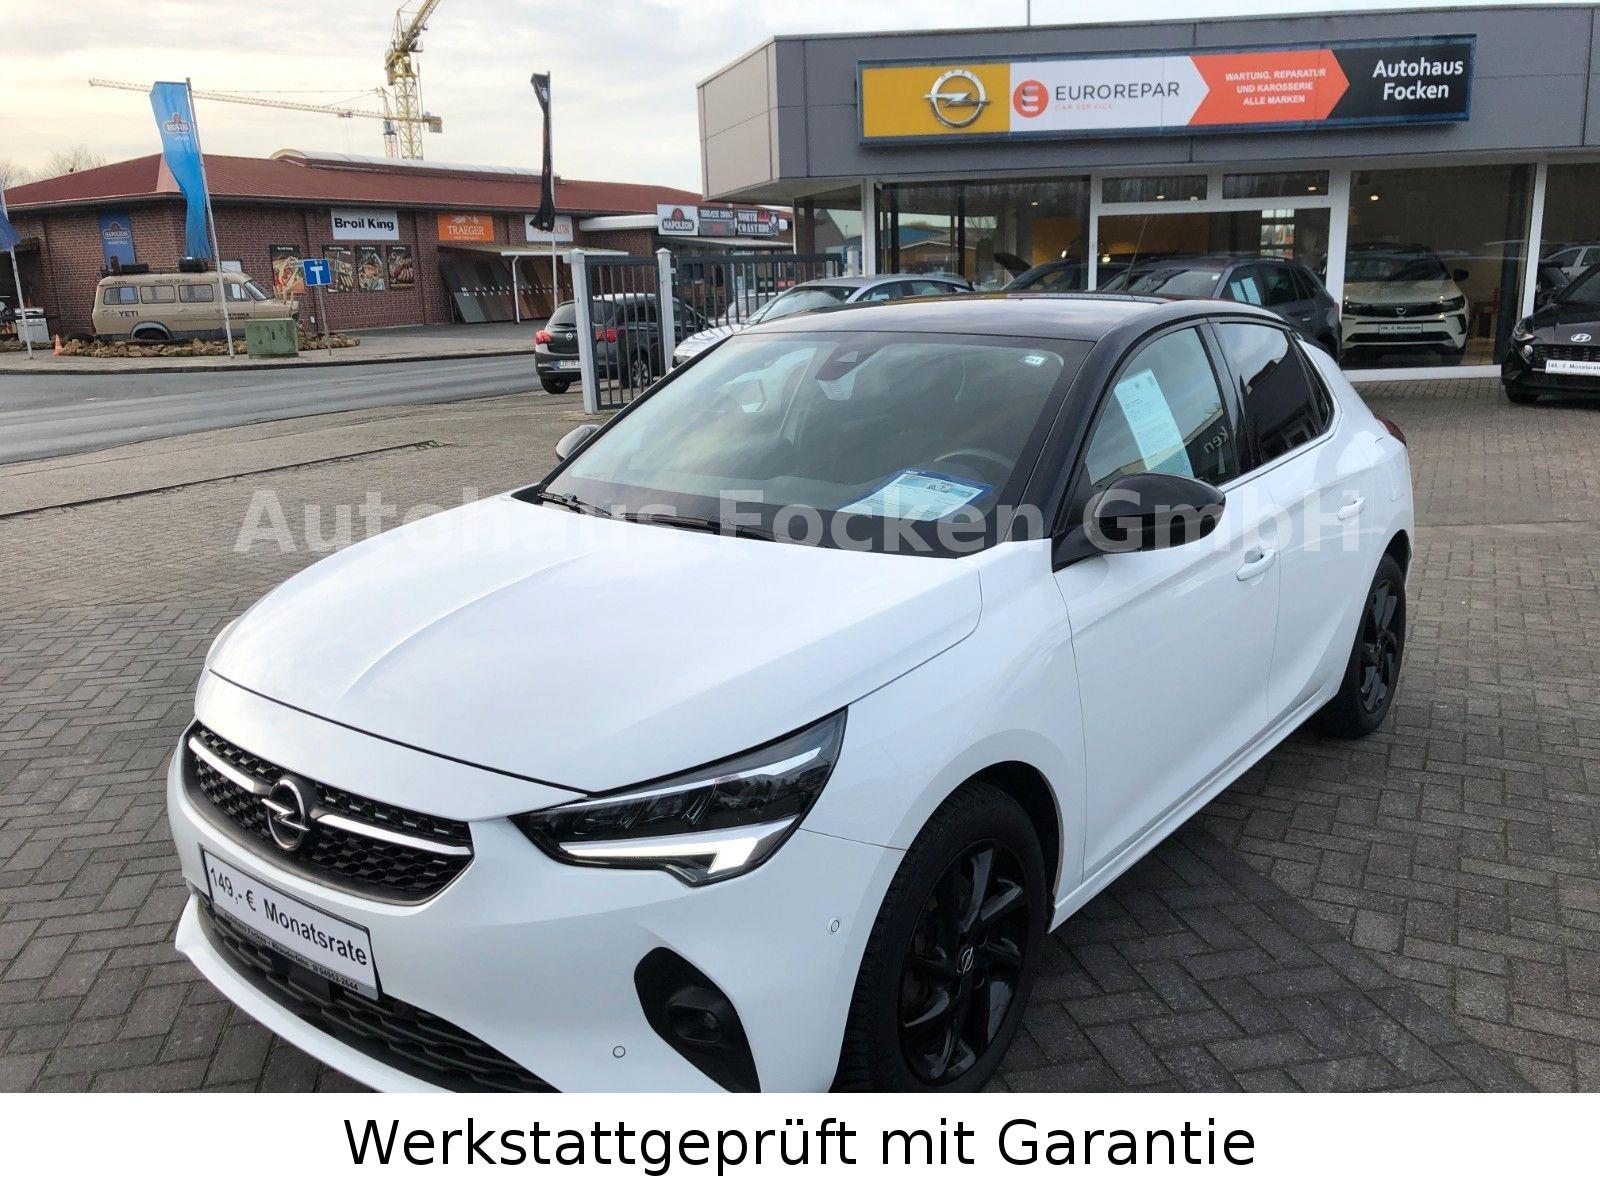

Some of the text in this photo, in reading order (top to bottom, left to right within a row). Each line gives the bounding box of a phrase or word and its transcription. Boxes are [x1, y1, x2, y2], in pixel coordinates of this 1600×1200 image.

[1273, 67, 1327, 79] REPARATUR
[1372, 56, 1464, 78] Autohaus
[1055, 81, 1180, 101] EUROREPAR
[1236, 81, 1314, 94] UND KAROSSERIE
[1383, 80, 1450, 101] Focken
[1243, 94, 1306, 106] ALLE MARKEN
[334, 217, 395, 231] Broil King
[447, 225, 485, 236] TRAEGER
[119, 310, 139, 318] YETI
[210, 867, 367, 966] 149,- € Monatsrate
